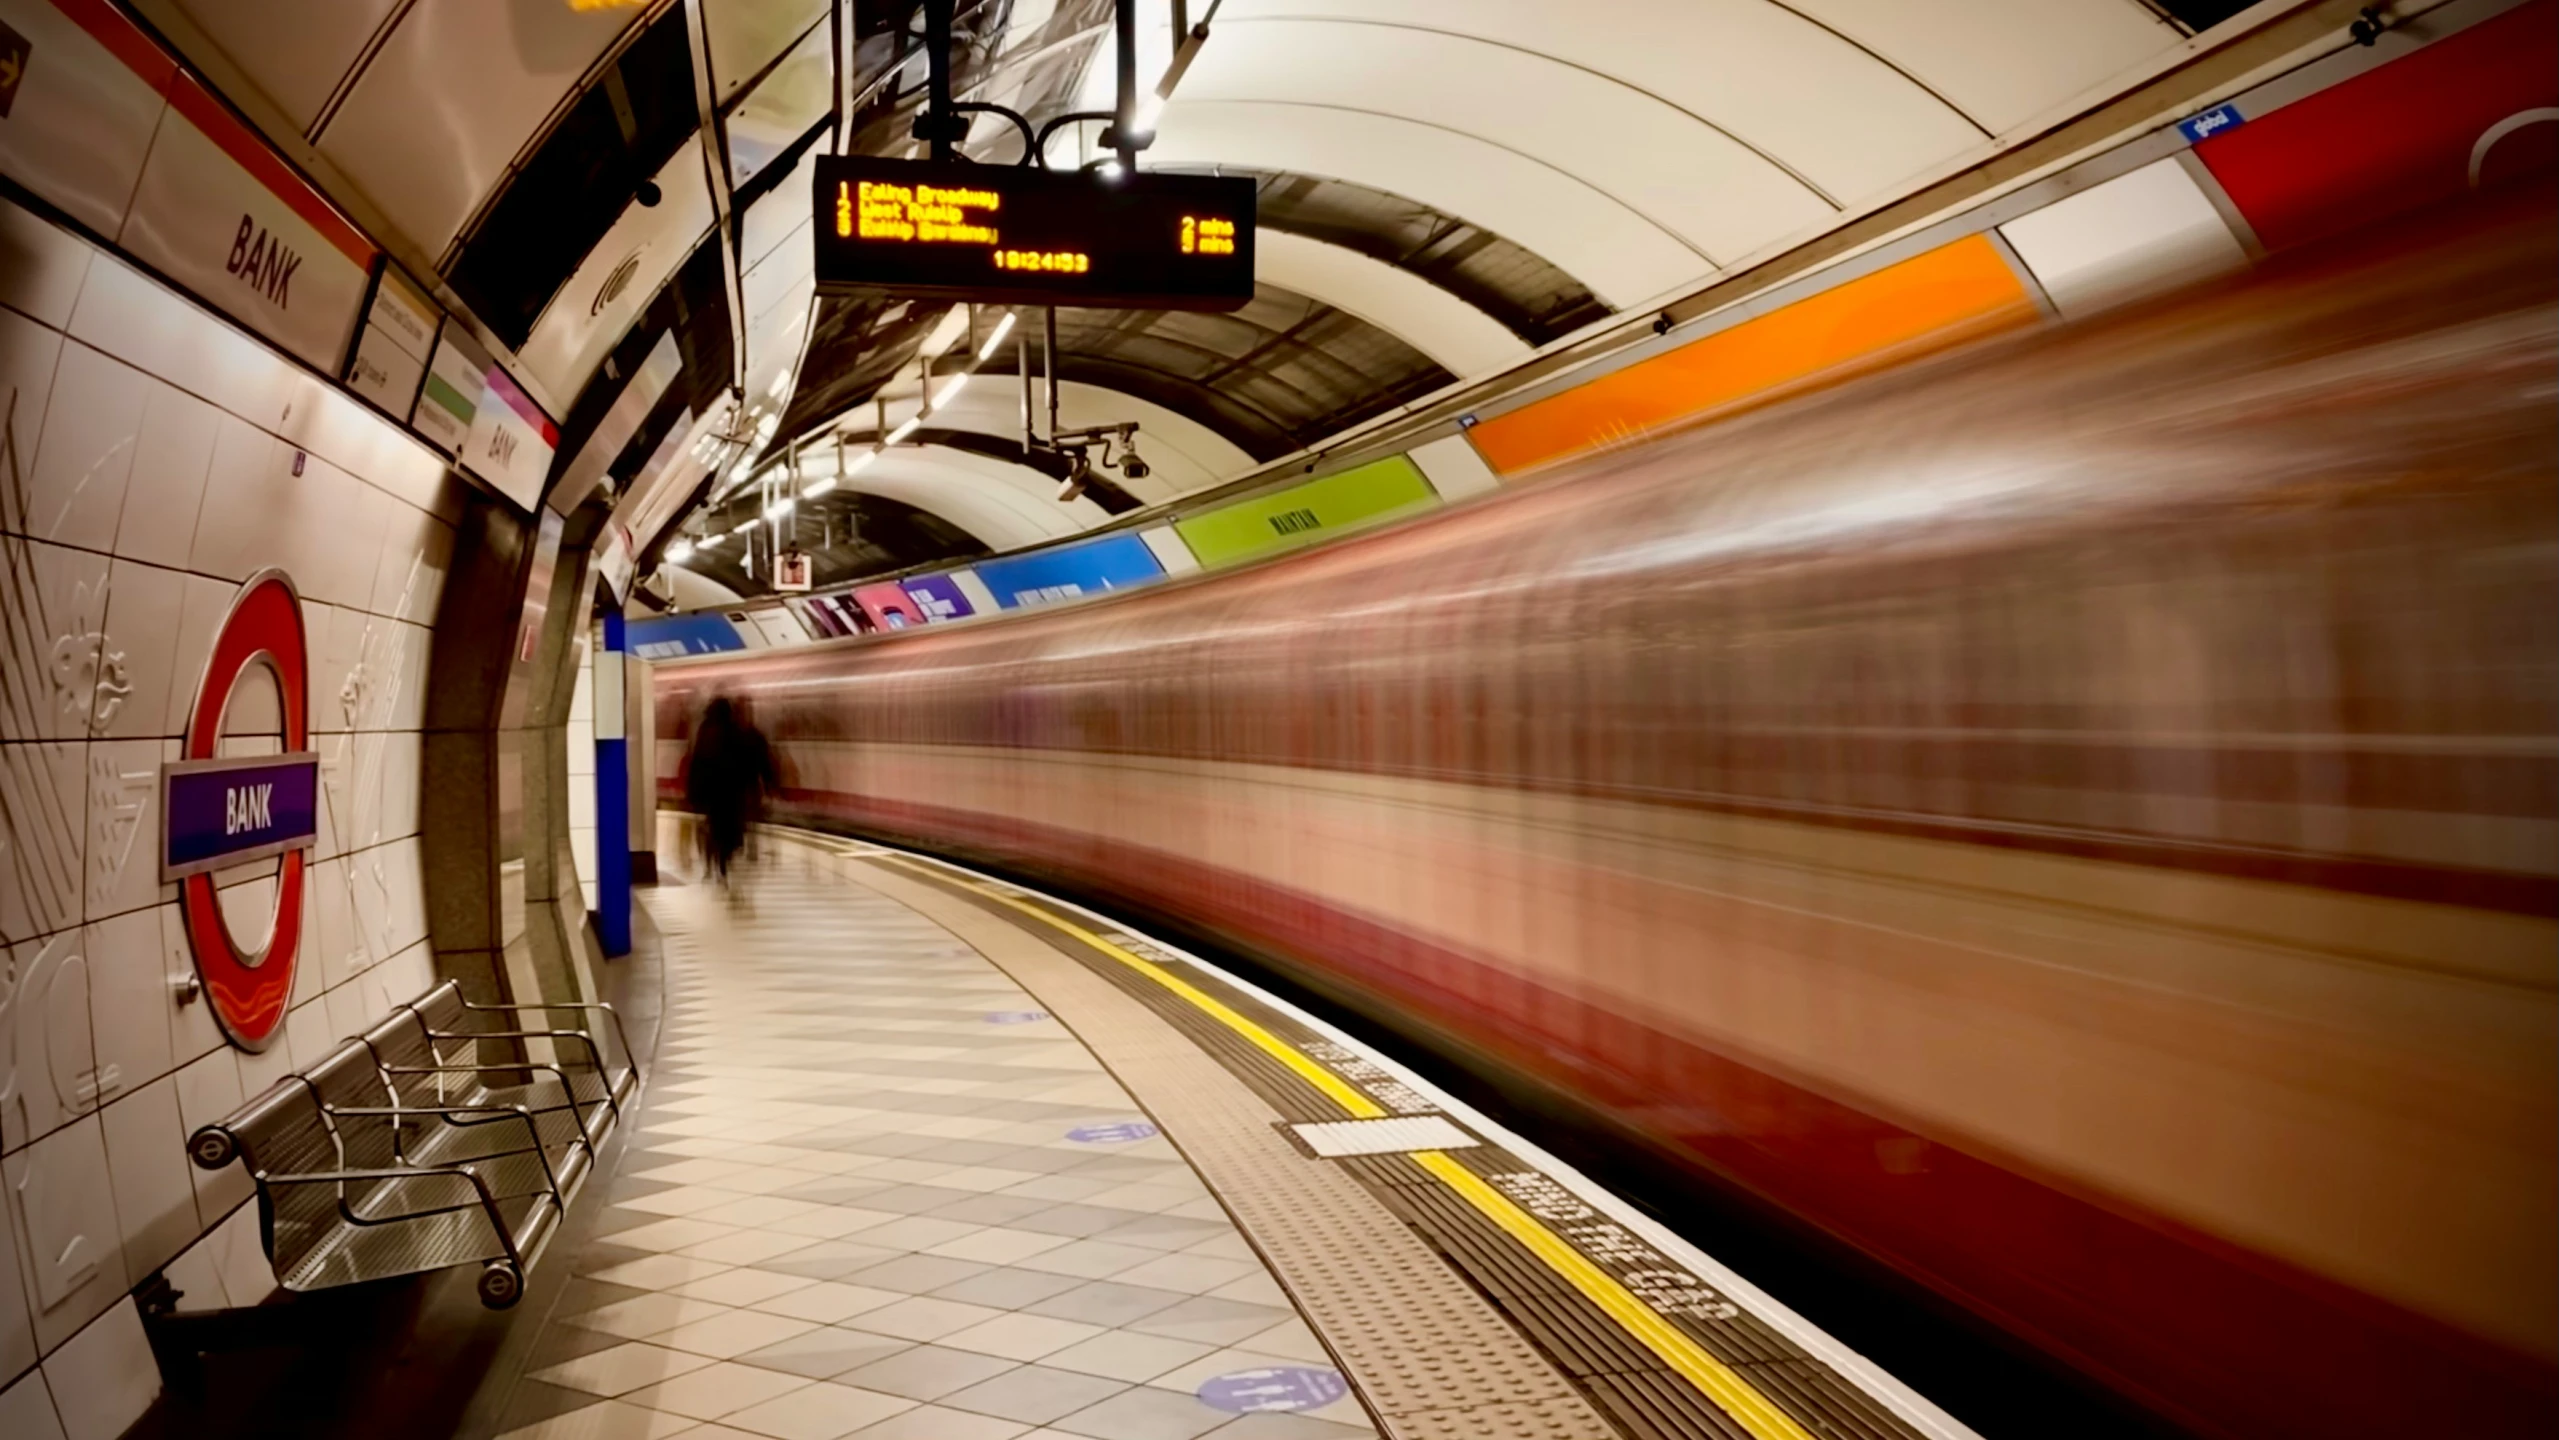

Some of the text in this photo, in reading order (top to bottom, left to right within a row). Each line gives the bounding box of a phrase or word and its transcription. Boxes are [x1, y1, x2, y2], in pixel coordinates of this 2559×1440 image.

[2193, 109, 2229, 138] global
[838, 180, 999, 211] 1 Ealing Broadway
[836, 198, 852, 217] 2
[858, 200, 903, 219] West
[1181, 216, 1195, 233] 2
[1199, 217, 1235, 236] mins
[225, 213, 303, 310] BANK
[1199, 235, 1235, 254] mins
[487, 422, 520, 472] BANK
[1267, 507, 1322, 537] MAINTAIN
[226, 782, 273, 836] BANK
[1491, 1171, 1739, 1320] MIND THE GAP
